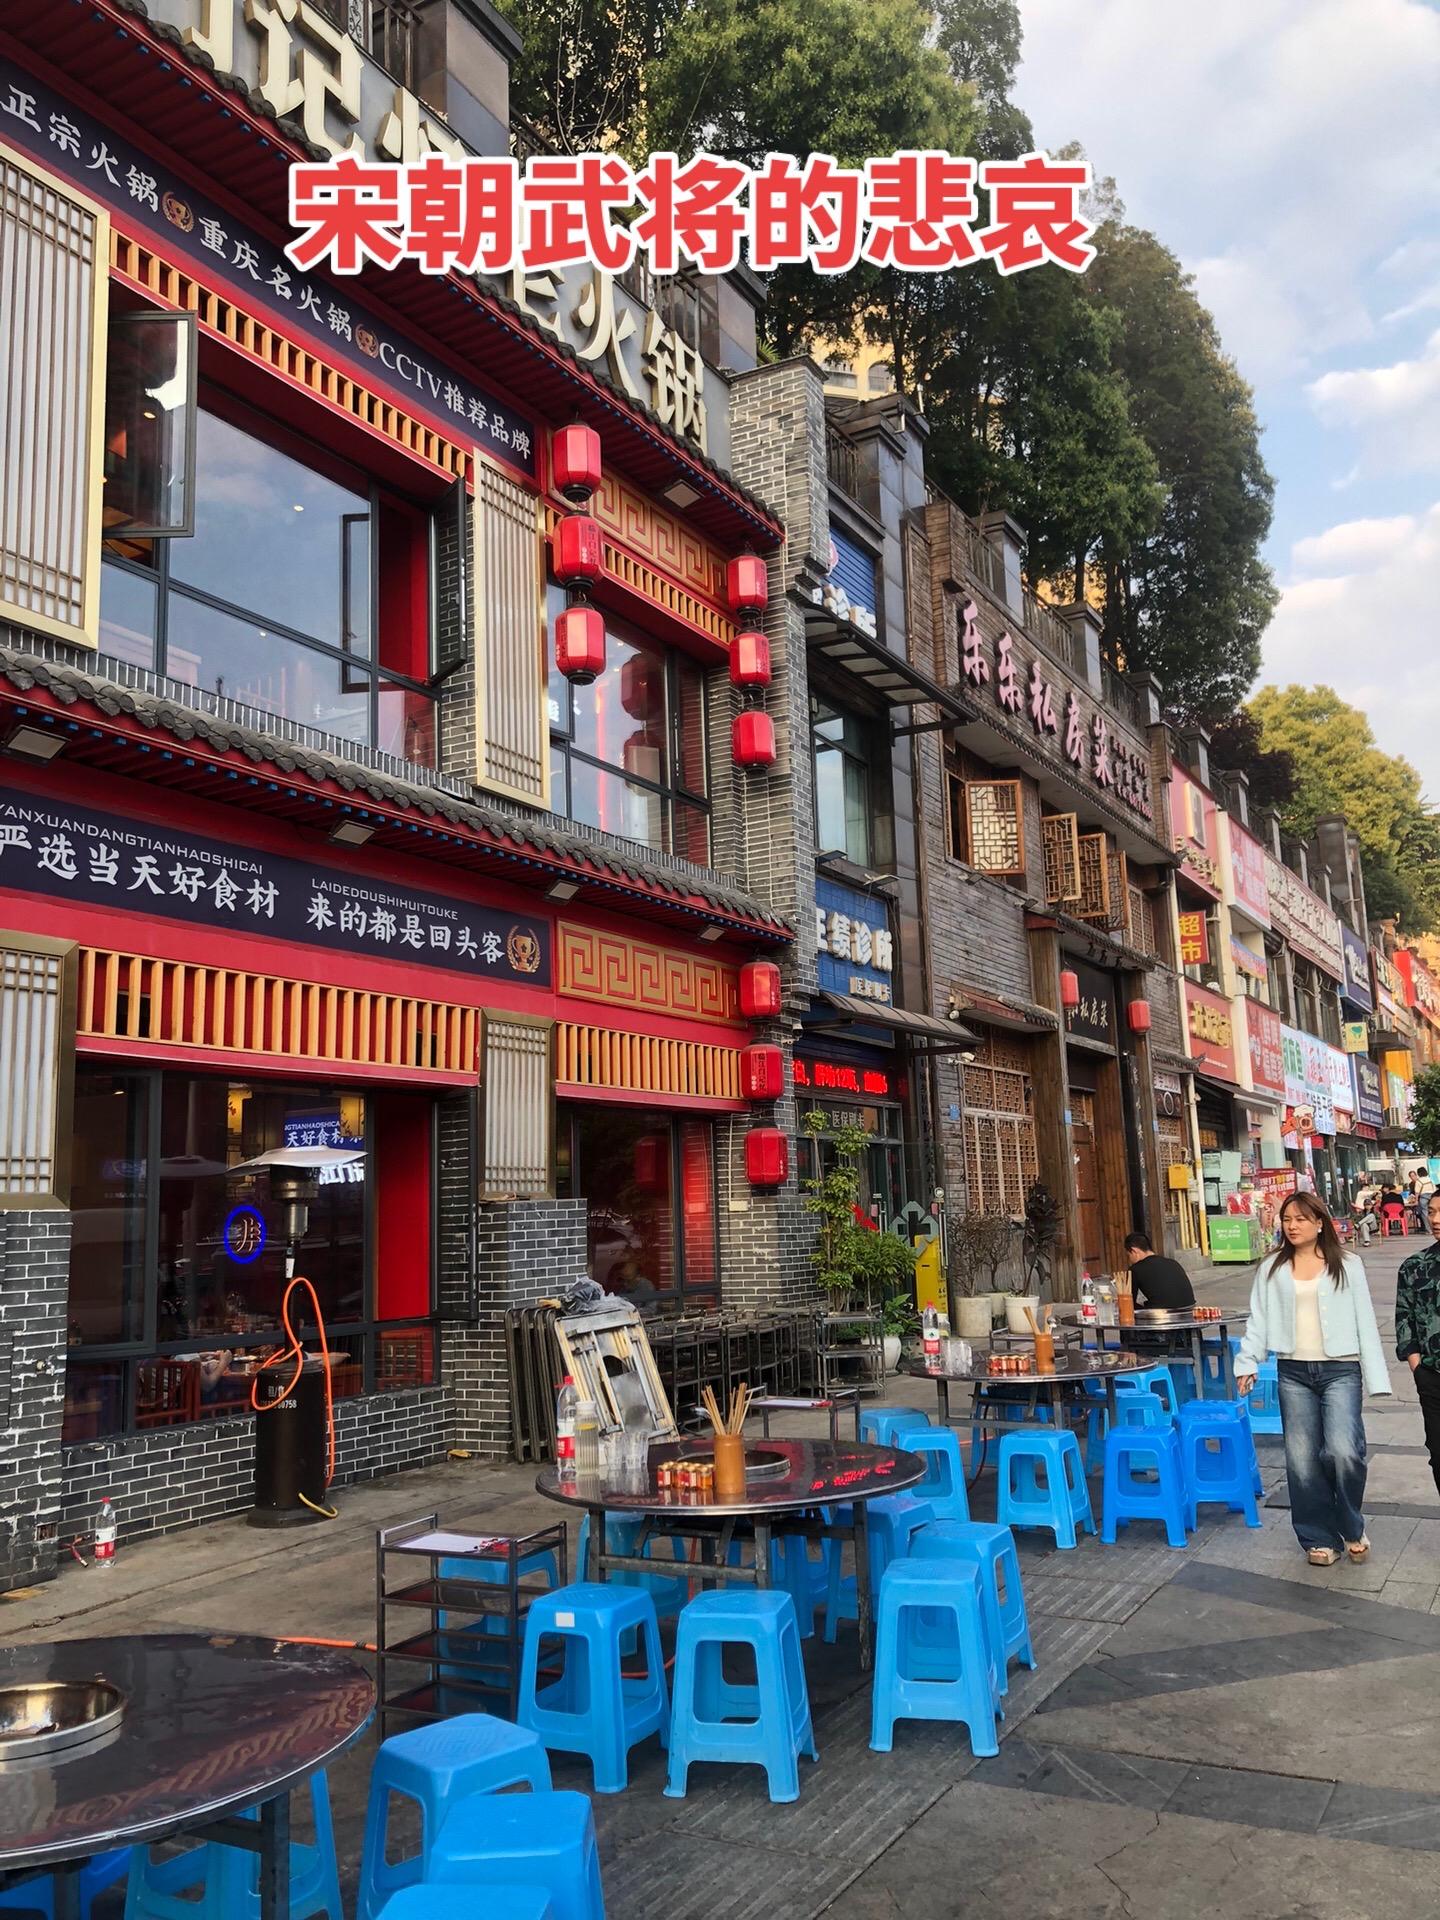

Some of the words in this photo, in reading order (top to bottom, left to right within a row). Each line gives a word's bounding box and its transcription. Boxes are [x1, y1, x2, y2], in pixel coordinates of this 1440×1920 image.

[0, 84, 159, 212] 正宗火锅
[199, 217, 352, 342] 重庆名火锅
[379, 342, 531, 460] CCTV推荐品牌
[0, 824, 279, 919] 严选当天好食材
[311, 877, 459, 921] LAIDEDOUSHIHUITOUKE
[306, 892, 506, 965] 来的都是回头客
[1179, 915, 1202, 962] 超市
